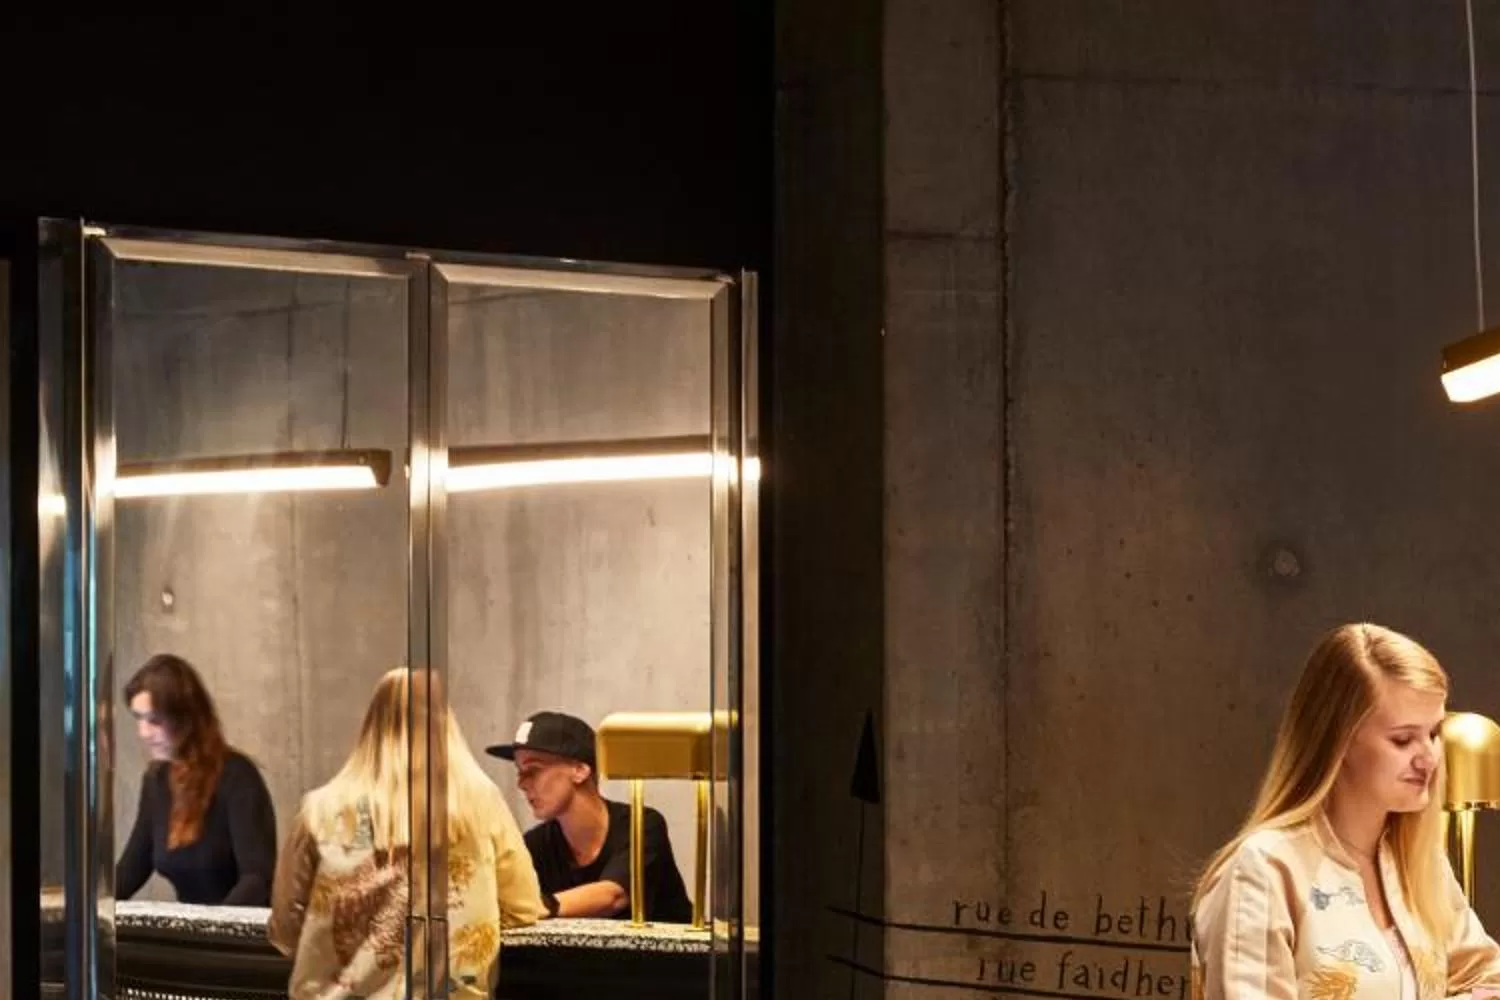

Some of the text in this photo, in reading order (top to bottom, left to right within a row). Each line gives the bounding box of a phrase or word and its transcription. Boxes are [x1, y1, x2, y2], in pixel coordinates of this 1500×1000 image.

[953, 898, 1012, 926] rue
[1029, 891, 1070, 929] de
[976, 958, 1036, 983] rue
